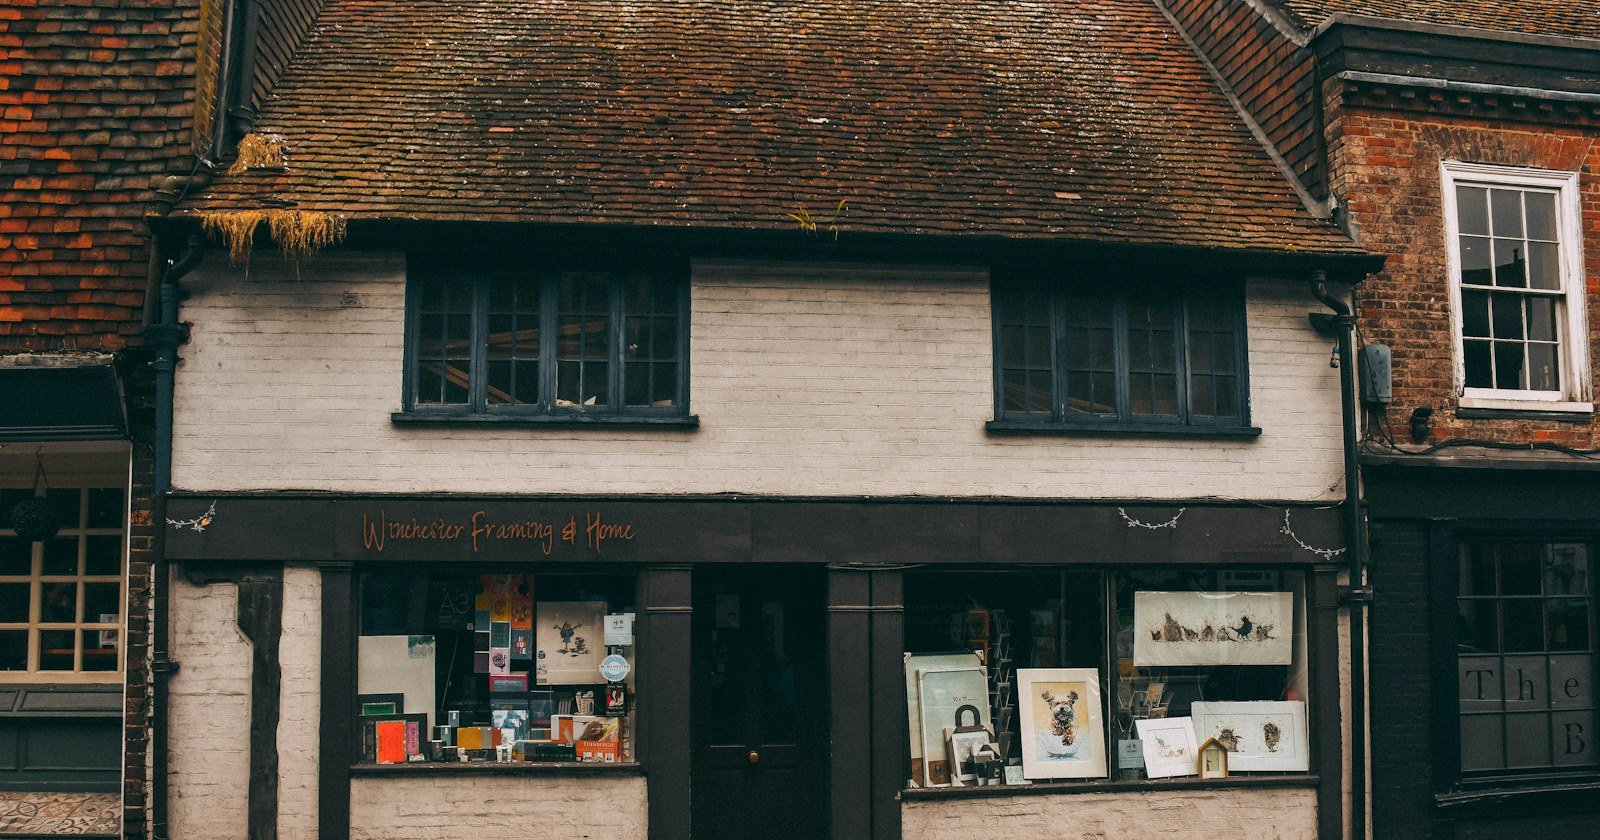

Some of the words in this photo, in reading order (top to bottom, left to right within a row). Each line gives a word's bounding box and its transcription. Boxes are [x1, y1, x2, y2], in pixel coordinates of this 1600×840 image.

[363, 510, 464, 551] Winchester
[471, 510, 553, 555] Framing
[562, 513, 577, 545] &
[586, 512, 636, 553] Home
[439, 593, 470, 614] A3
[1466, 668, 1580, 700] The
[1560, 722, 1585, 755] B
